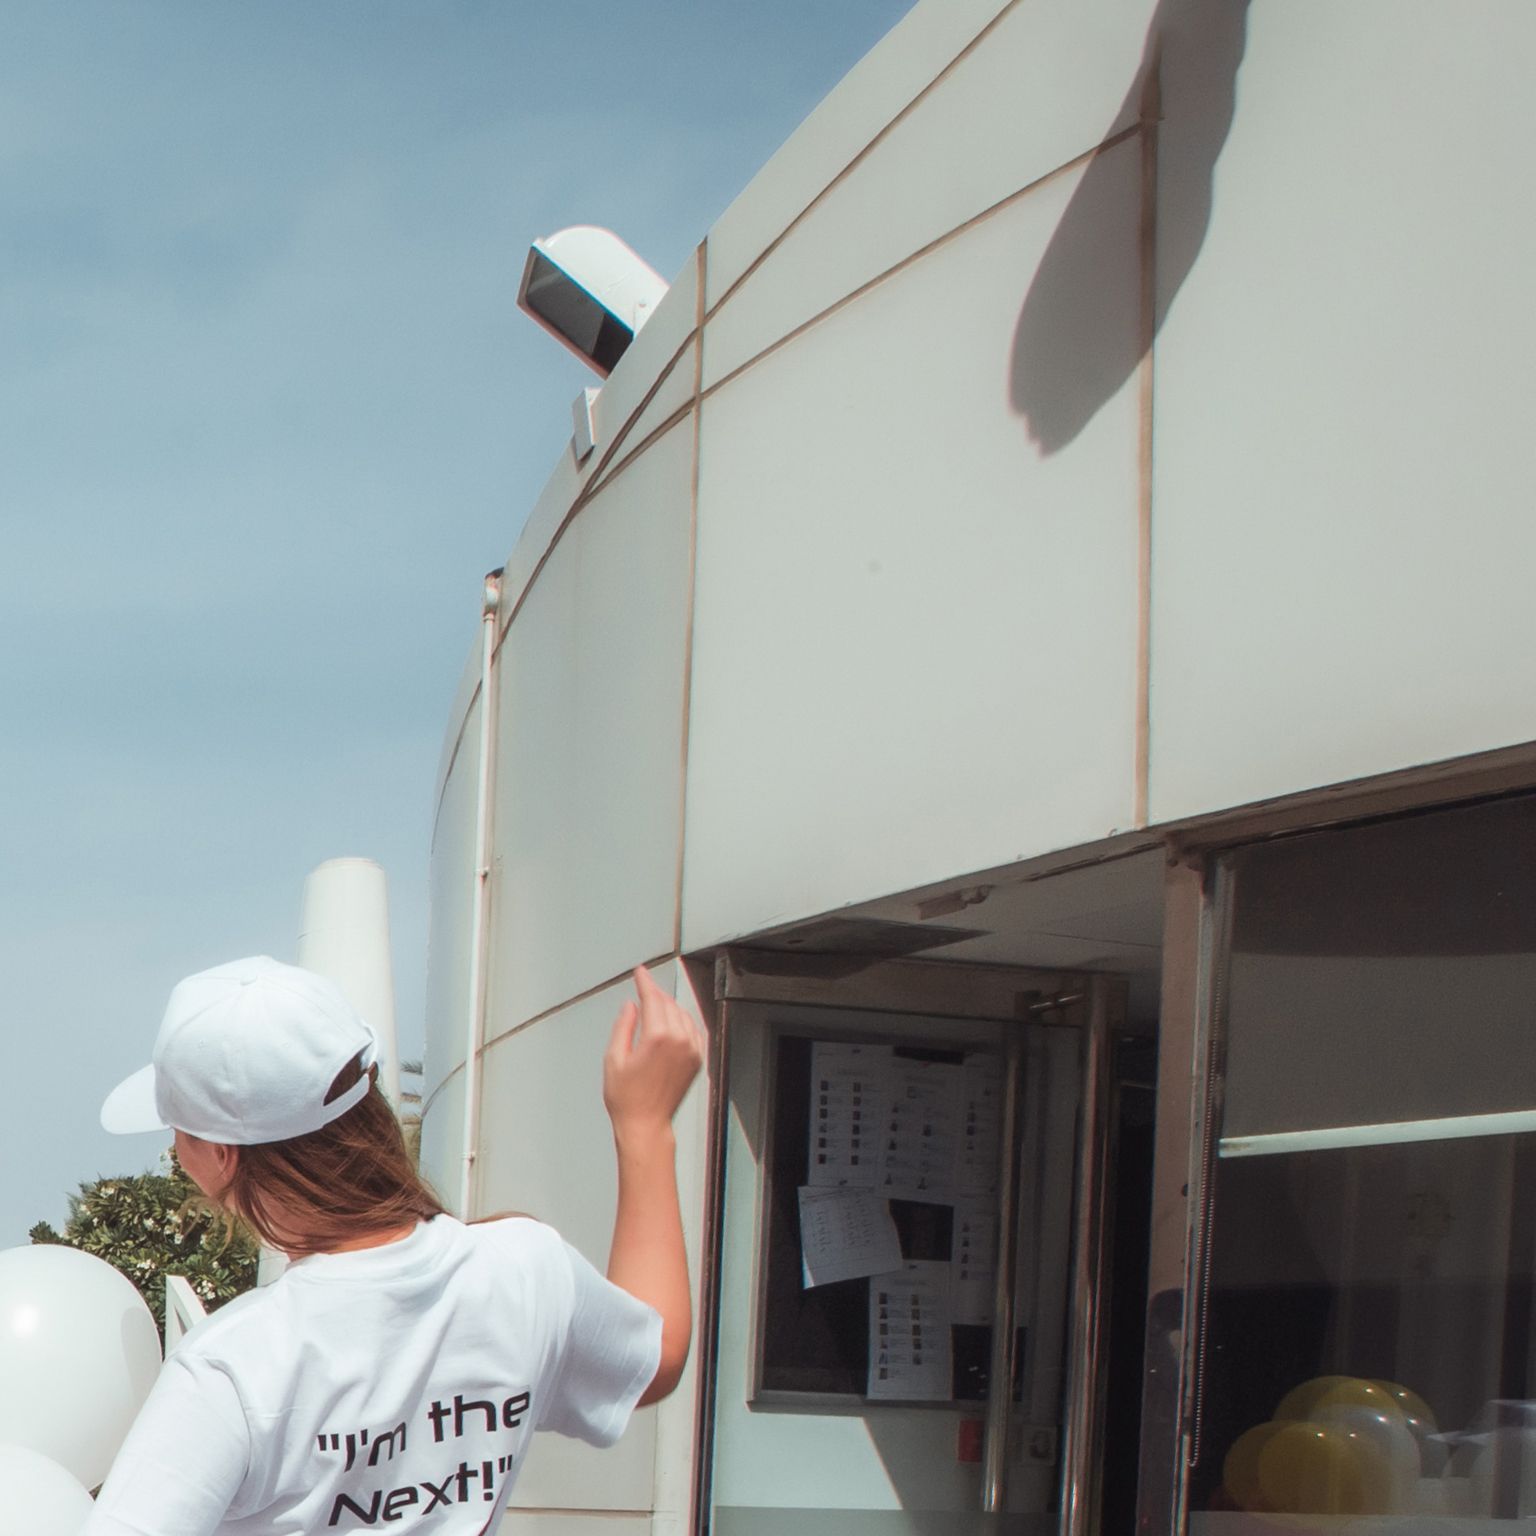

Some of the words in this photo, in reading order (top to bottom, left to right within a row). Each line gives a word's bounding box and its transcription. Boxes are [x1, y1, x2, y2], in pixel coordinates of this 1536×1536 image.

[316, 1422, 407, 1473] "I'm
[428, 1391, 530, 1443] the
[328, 1454, 513, 1527] Next!"
